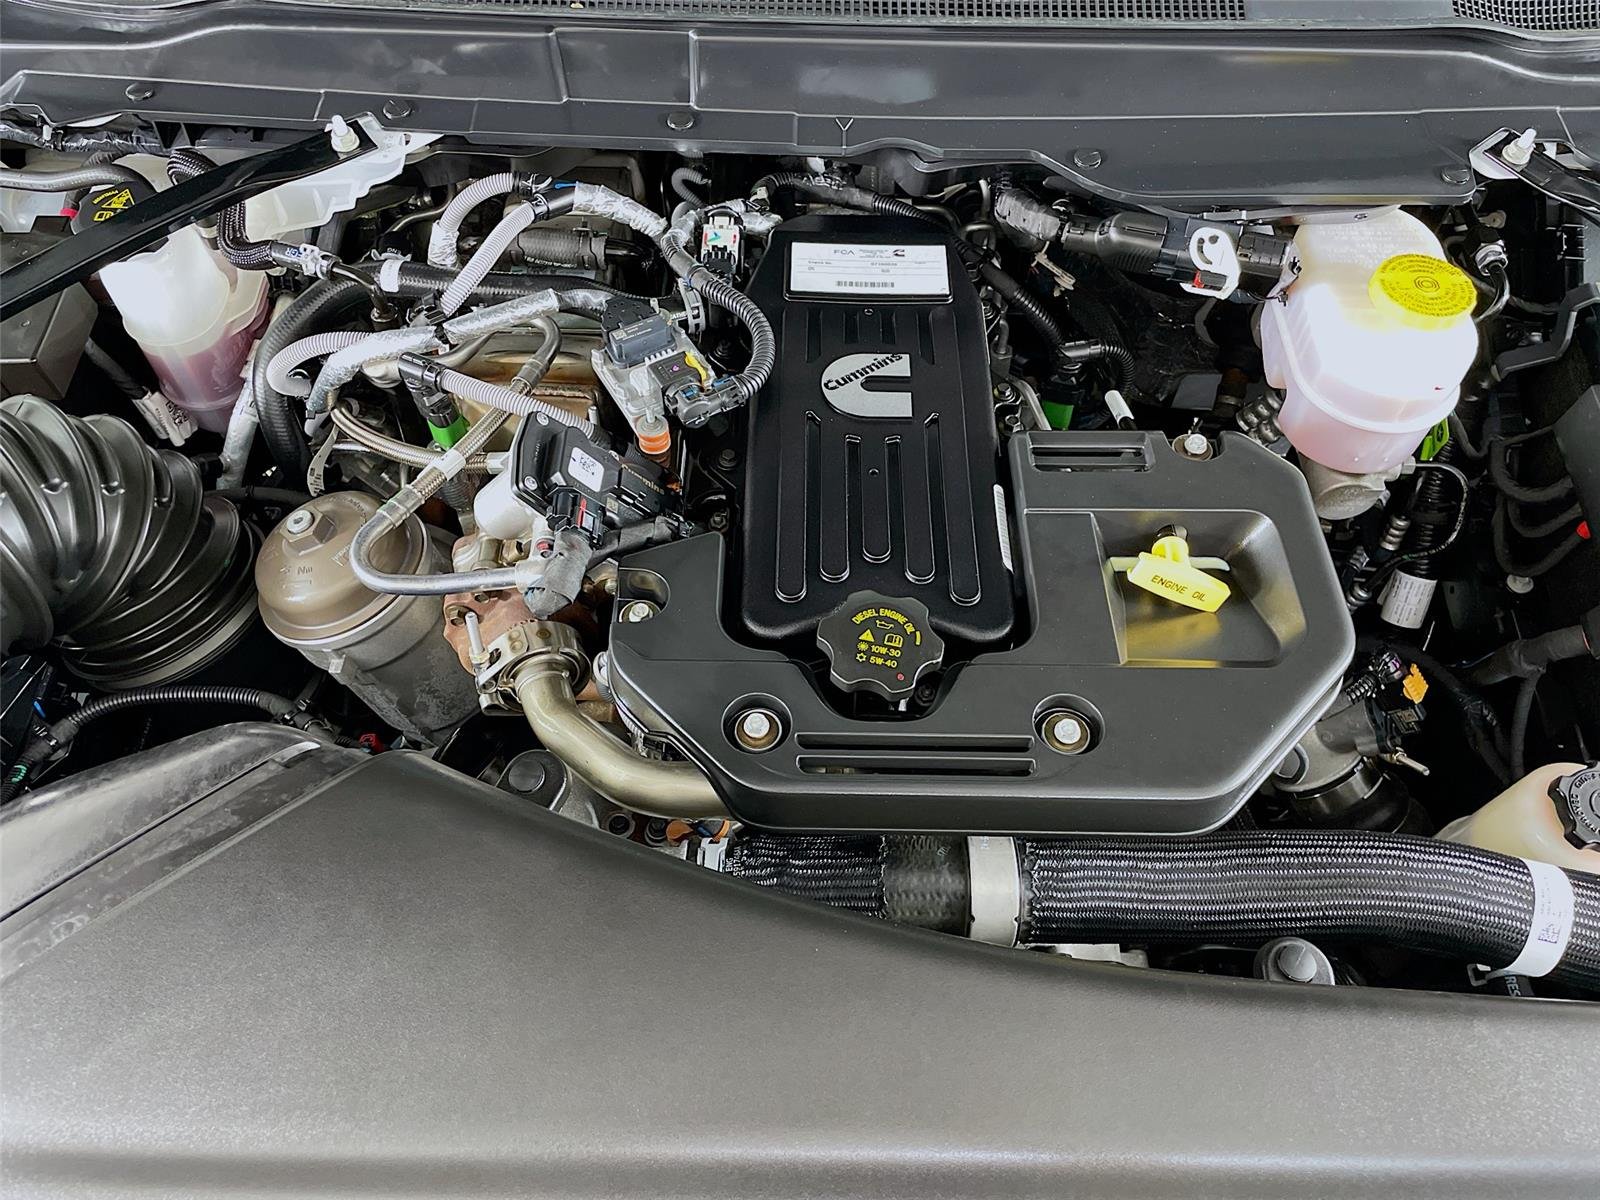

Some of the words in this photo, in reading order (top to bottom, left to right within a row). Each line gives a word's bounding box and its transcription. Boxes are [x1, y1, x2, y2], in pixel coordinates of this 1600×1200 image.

[823, 353, 903, 390] Cummins
[1151, 575, 1188, 594] ENGINE
[1191, 591, 1208, 602] OIL
[851, 608, 879, 625] DIESEL
[879, 608, 909, 625] ENGINE
[903, 622, 916, 635] OIL
[868, 655, 898, 669] 5W-40
[870, 645, 901, 658] 10W-30
